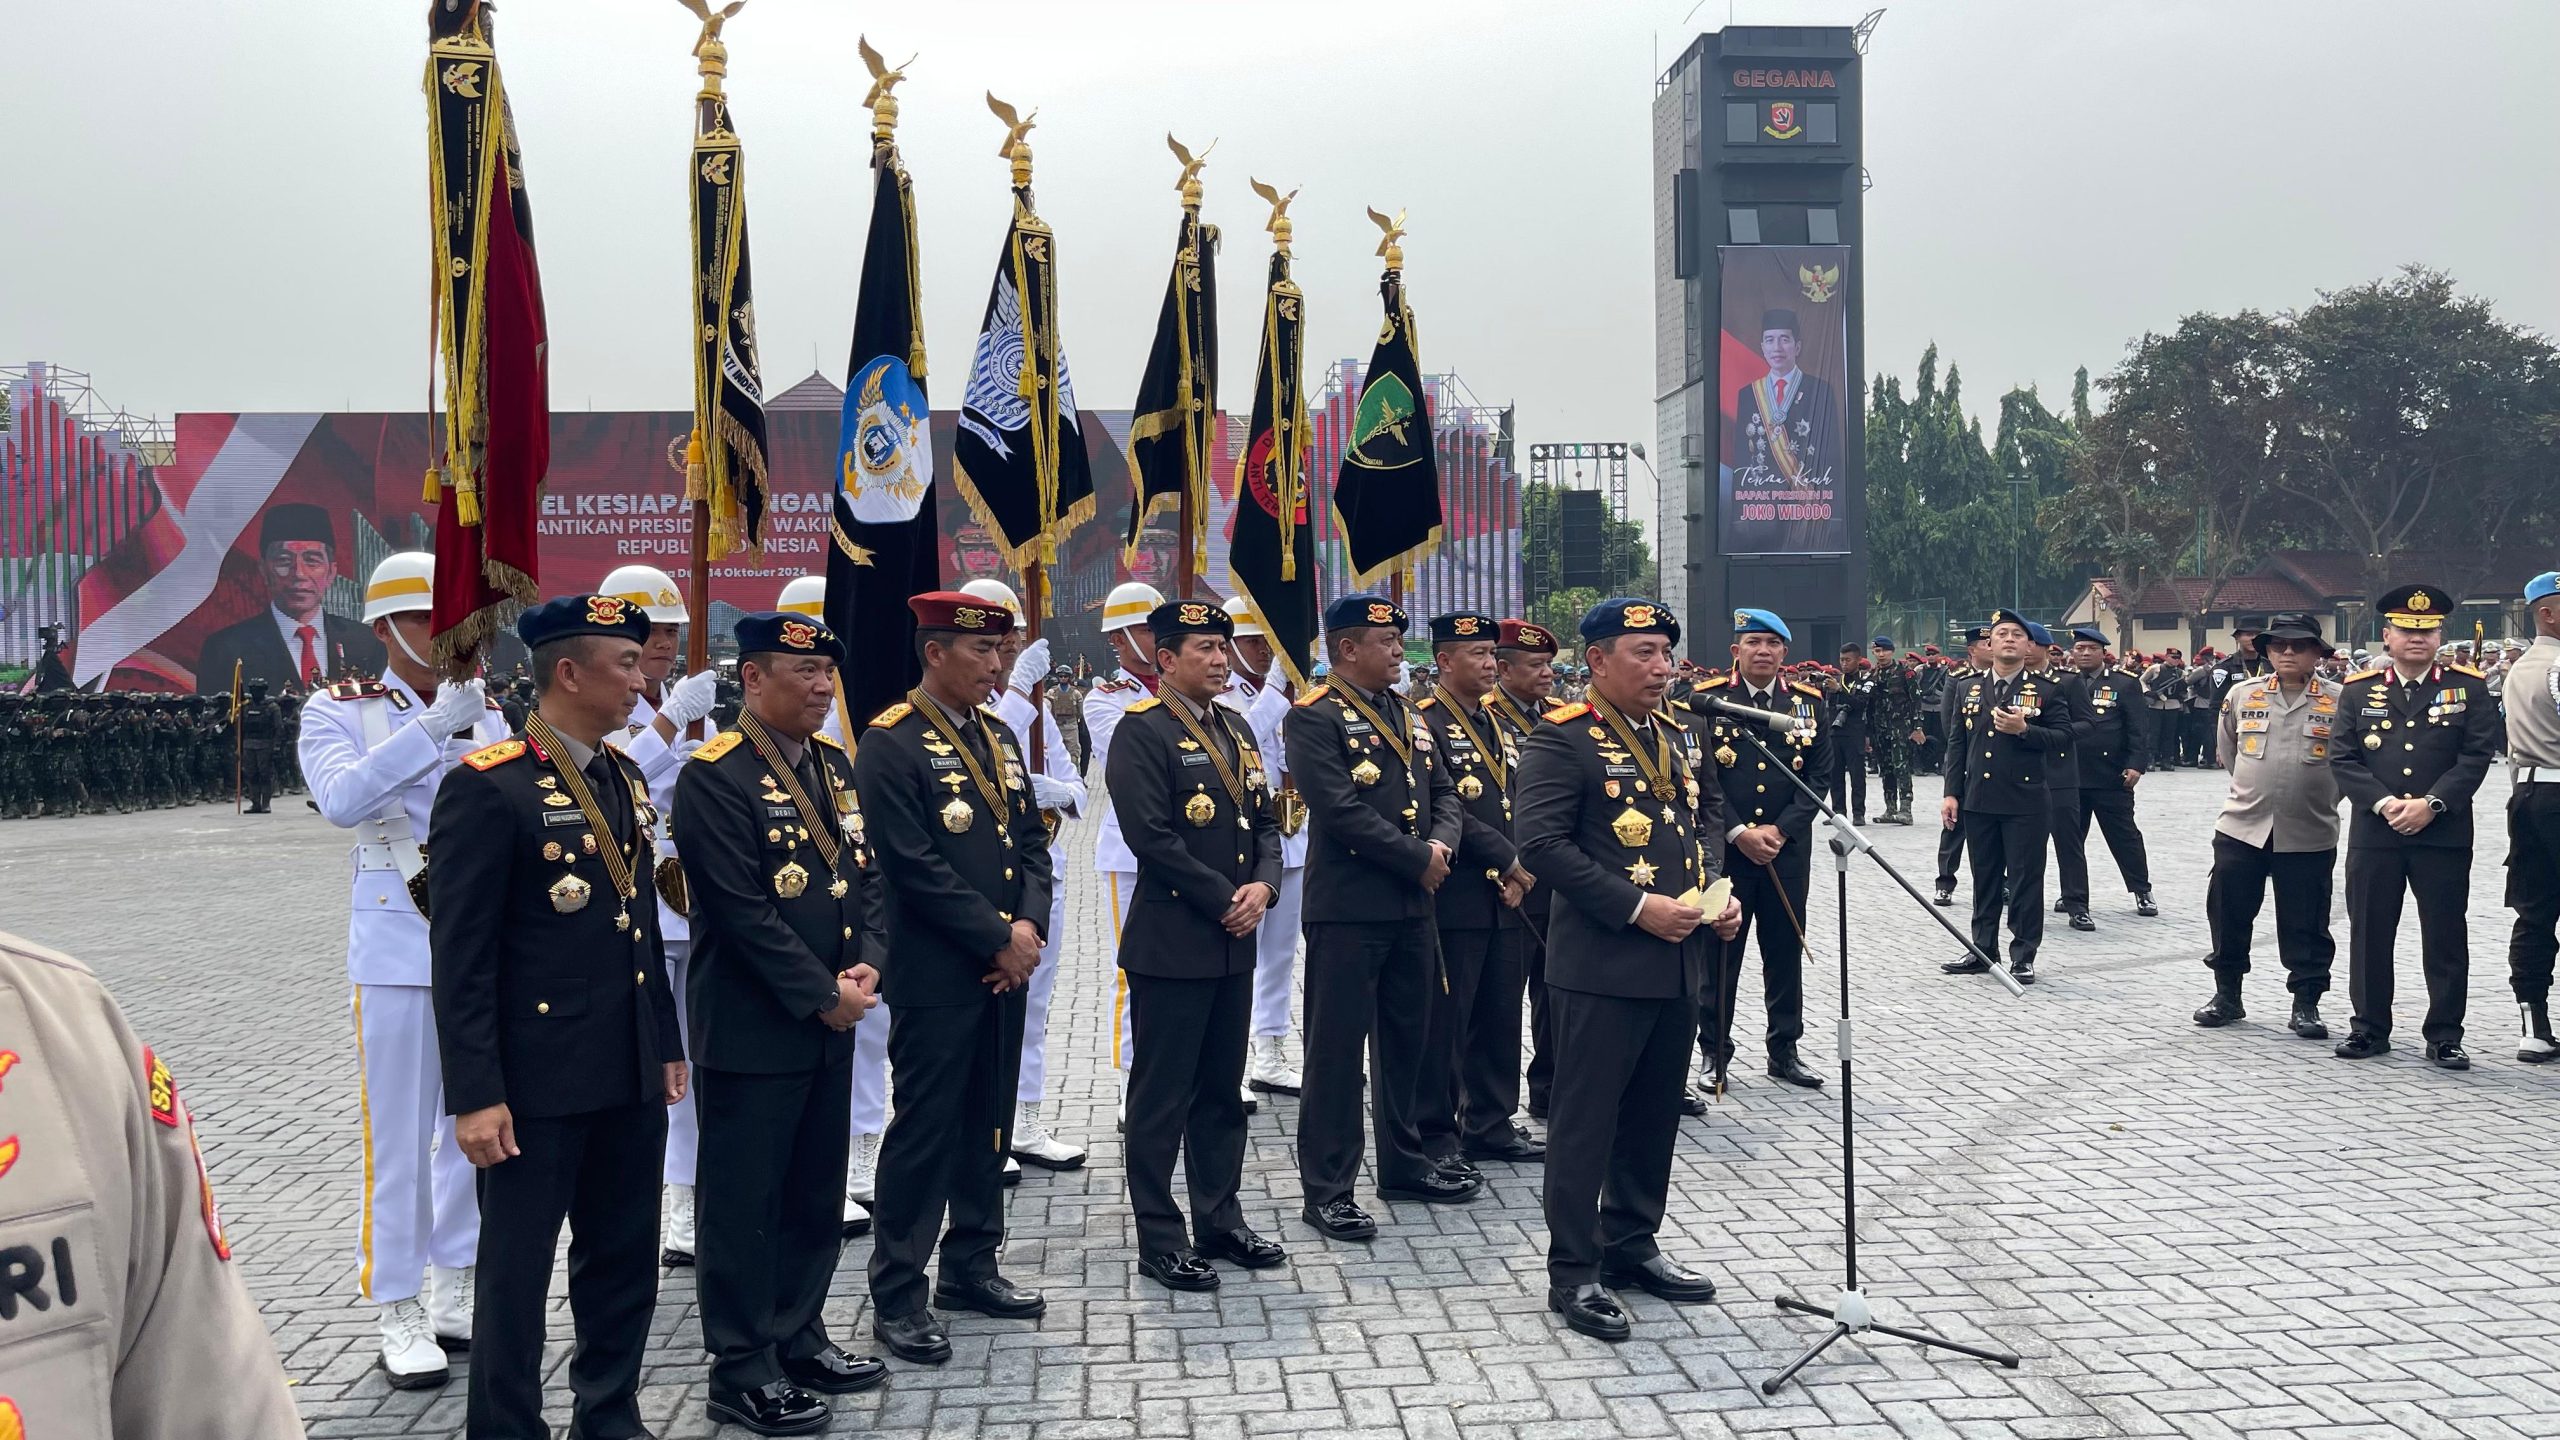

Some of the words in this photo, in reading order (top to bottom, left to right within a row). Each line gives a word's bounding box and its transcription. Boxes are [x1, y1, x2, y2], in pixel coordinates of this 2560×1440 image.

[1733, 69, 1836, 88] GEGANA
[1735, 490, 1769, 500] BAPAK
[541, 495, 571, 516] EL
[576, 494, 693, 515] KESIAPA
[1740, 503, 1776, 520] JOKO
[1778, 503, 1832, 520] WIDODO
[537, 519, 624, 535] ANTIKAN
[628, 518, 692, 534] PRESID
[777, 567, 807, 577] 2024
[2241, 710, 2269, 719] ERDI
[0, 1236, 77, 1321] RI
